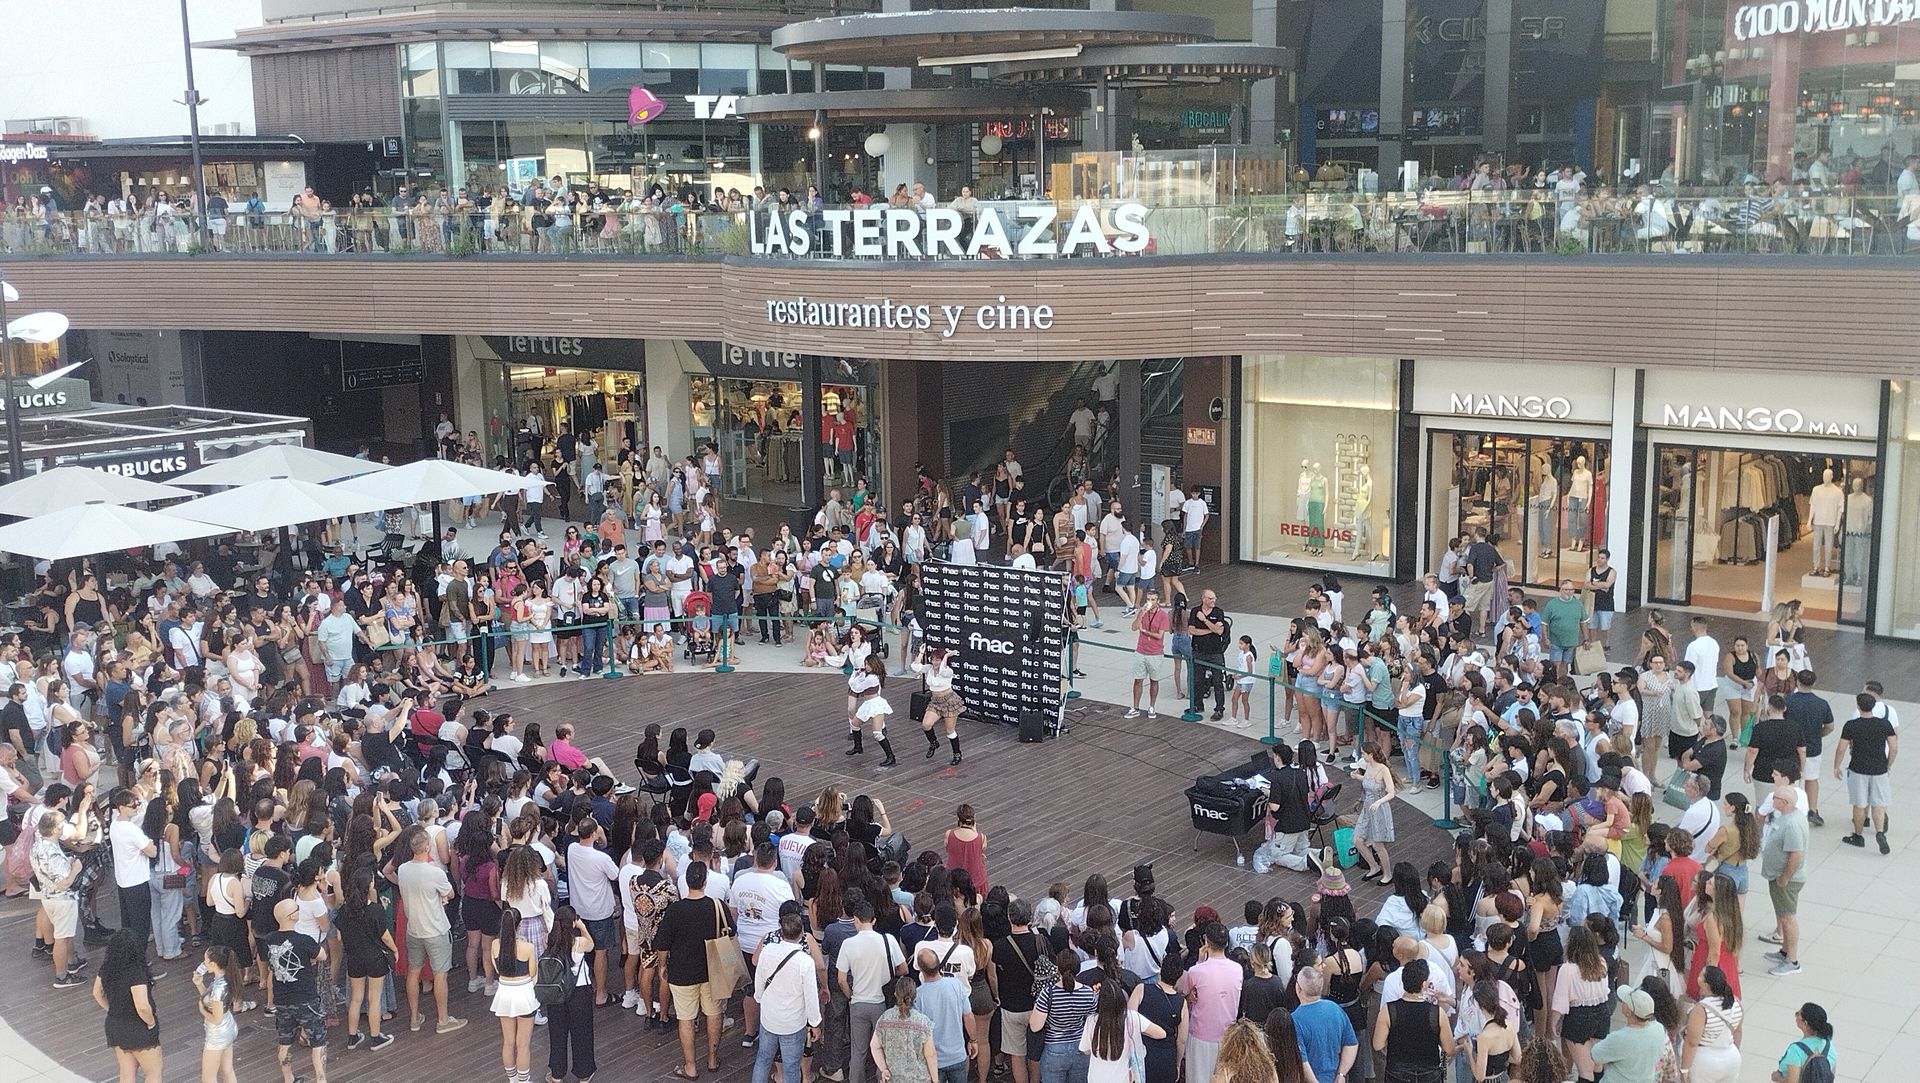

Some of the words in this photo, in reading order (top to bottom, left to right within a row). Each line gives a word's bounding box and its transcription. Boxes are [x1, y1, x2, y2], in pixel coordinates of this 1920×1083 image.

[1438, 17, 1568, 41] CINSA
[685, 95, 747, 119] TA
[751, 209, 811, 256] LAS
[823, 203, 1150, 257] TERRAZAS
[767, 296, 932, 330] restaurantes
[942, 304, 965, 338] y
[976, 295, 1055, 330] cine
[722, 340, 802, 369] leftie
[1450, 392, 1572, 420] MANGO
[1663, 403, 1803, 434] MANGO
[1808, 421, 1859, 437] MAN
[1280, 522, 1351, 542] REBAJAS
[922, 565, 939, 573] fnac
[942, 566, 959, 575] fnac
[962, 568, 979, 577] fnac
[982, 570, 1000, 578] fnac
[1003, 571, 1020, 580] fnac
[1024, 573, 1040, 582] fnac
[1044, 576, 1061, 585] fnac
[923, 576, 940, 585] fnac
[942, 578, 960, 587] fnac
[963, 580, 980, 588] fnac
[983, 582, 1000, 590] fnac
[1003, 583, 1020, 592] fnac
[1023, 586, 1040, 595] fnac
[1043, 588, 1061, 597] fnac
[924, 588, 940, 596] fnac
[943, 589, 960, 598] fnac
[963, 591, 980, 600] fnac
[983, 593, 1000, 602] fnac
[1003, 595, 1020, 604] fnac
[1023, 598, 1040, 607] fnac
[1044, 600, 1061, 609] fnac
[925, 599, 941, 608] fnac
[944, 601, 961, 610] fnac
[963, 603, 980, 612] fnac
[983, 605, 1000, 614] fnac
[1003, 607, 1020, 616] fnac
[1023, 610, 1032, 618] fn
[1044, 612, 1061, 621] fnac
[926, 611, 941, 619] fnac
[944, 613, 961, 621] fnac
[963, 615, 980, 624] fnac
[983, 617, 1000, 626] fnac
[1002, 619, 1020, 628] fnac
[1043, 624, 1061, 633] fnac
[944, 624, 961, 633] fnac
[1043, 636, 1061, 645] fnac
[968, 631, 1015, 655] fnac
[926, 633, 941, 642] fnac
[944, 636, 960, 645] fnac
[1022, 645, 1040, 655] fnc
[1043, 648, 1061, 658] fnac
[963, 661, 979, 671] fnac
[982, 664, 999, 674] fnac
[1001, 667, 1018, 677] fnac
[1021, 670, 1039, 679] fnc
[1042, 672, 1060, 682] fnac
[1022, 658, 1040, 667] fnc
[1042, 660, 1060, 670] fnac
[963, 673, 980, 683] fnac
[982, 676, 999, 686] fnac
[1001, 679, 1018, 689] fnac
[1021, 682, 1039, 691] fnc
[1042, 684, 1060, 694] fnac
[964, 685, 979, 695] fnac
[982, 688, 999, 697] fnac
[1001, 691, 1018, 700] fnac
[1021, 694, 1039, 703] fnc
[1042, 697, 1060, 706] fnac
[965, 696, 980, 706] fnac
[982, 700, 999, 709] fnac
[1001, 703, 1018, 712] fnac
[1002, 714, 1019, 723] fnac
[1193, 803, 1229, 821] fnac
